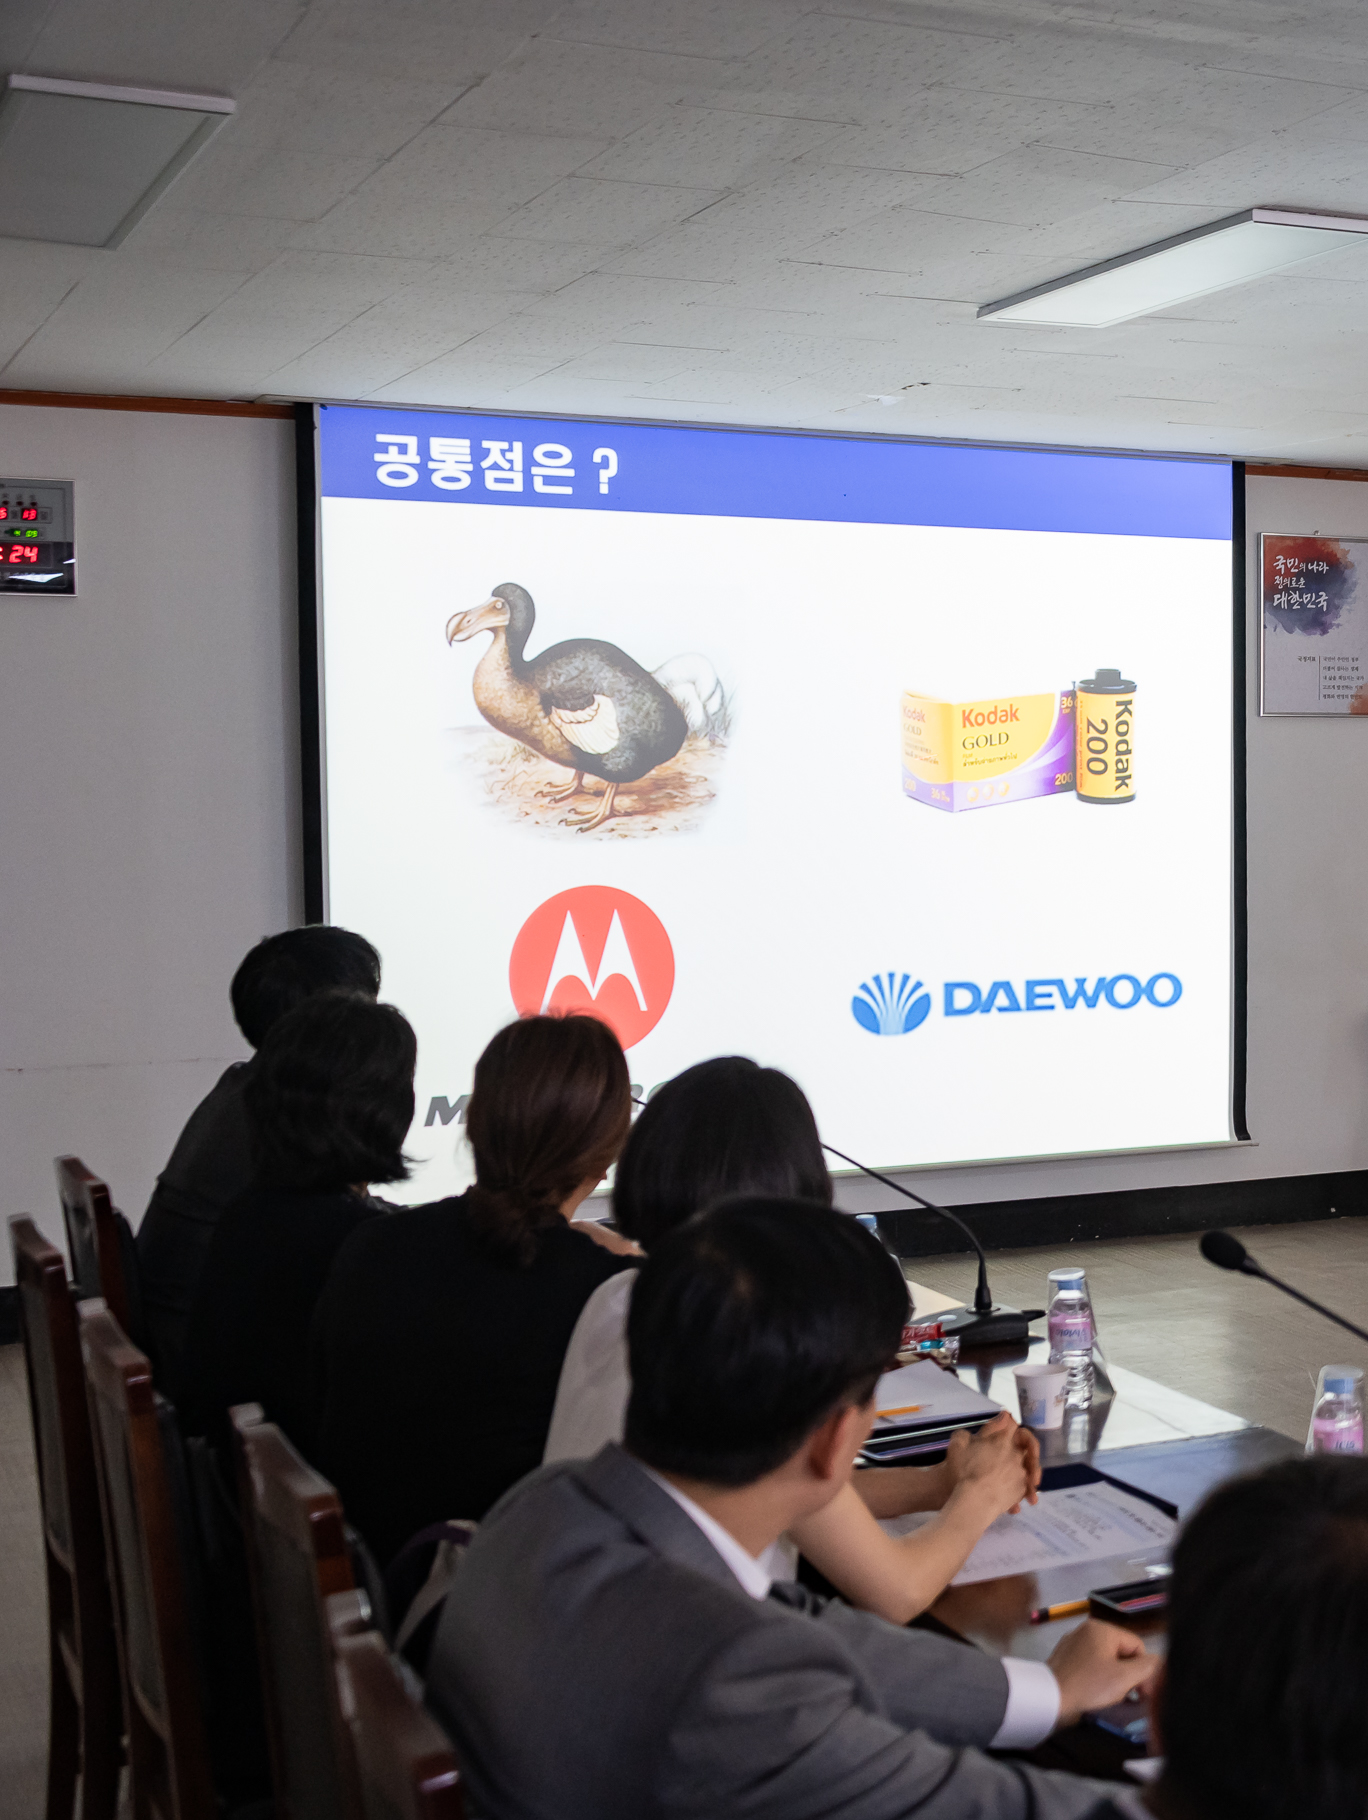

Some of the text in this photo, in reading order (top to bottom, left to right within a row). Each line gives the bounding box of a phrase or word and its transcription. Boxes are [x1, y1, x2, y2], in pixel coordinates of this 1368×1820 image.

[373, 433, 576, 496] 공통점은
[1273, 555, 1330, 575] 국민의 나라
[1273, 575, 1306, 589] 정의로운
[1273, 590, 1329, 612] 대한민국
[1061, 696, 1074, 709] 36
[962, 703, 1021, 729] Kodak
[962, 731, 1010, 751] GOLD
[1086, 716, 1109, 776] 200
[1115, 699, 1133, 792] Kodak
[1054, 771, 1074, 786] 200
[943, 972, 1183, 1017] DAEWOO
